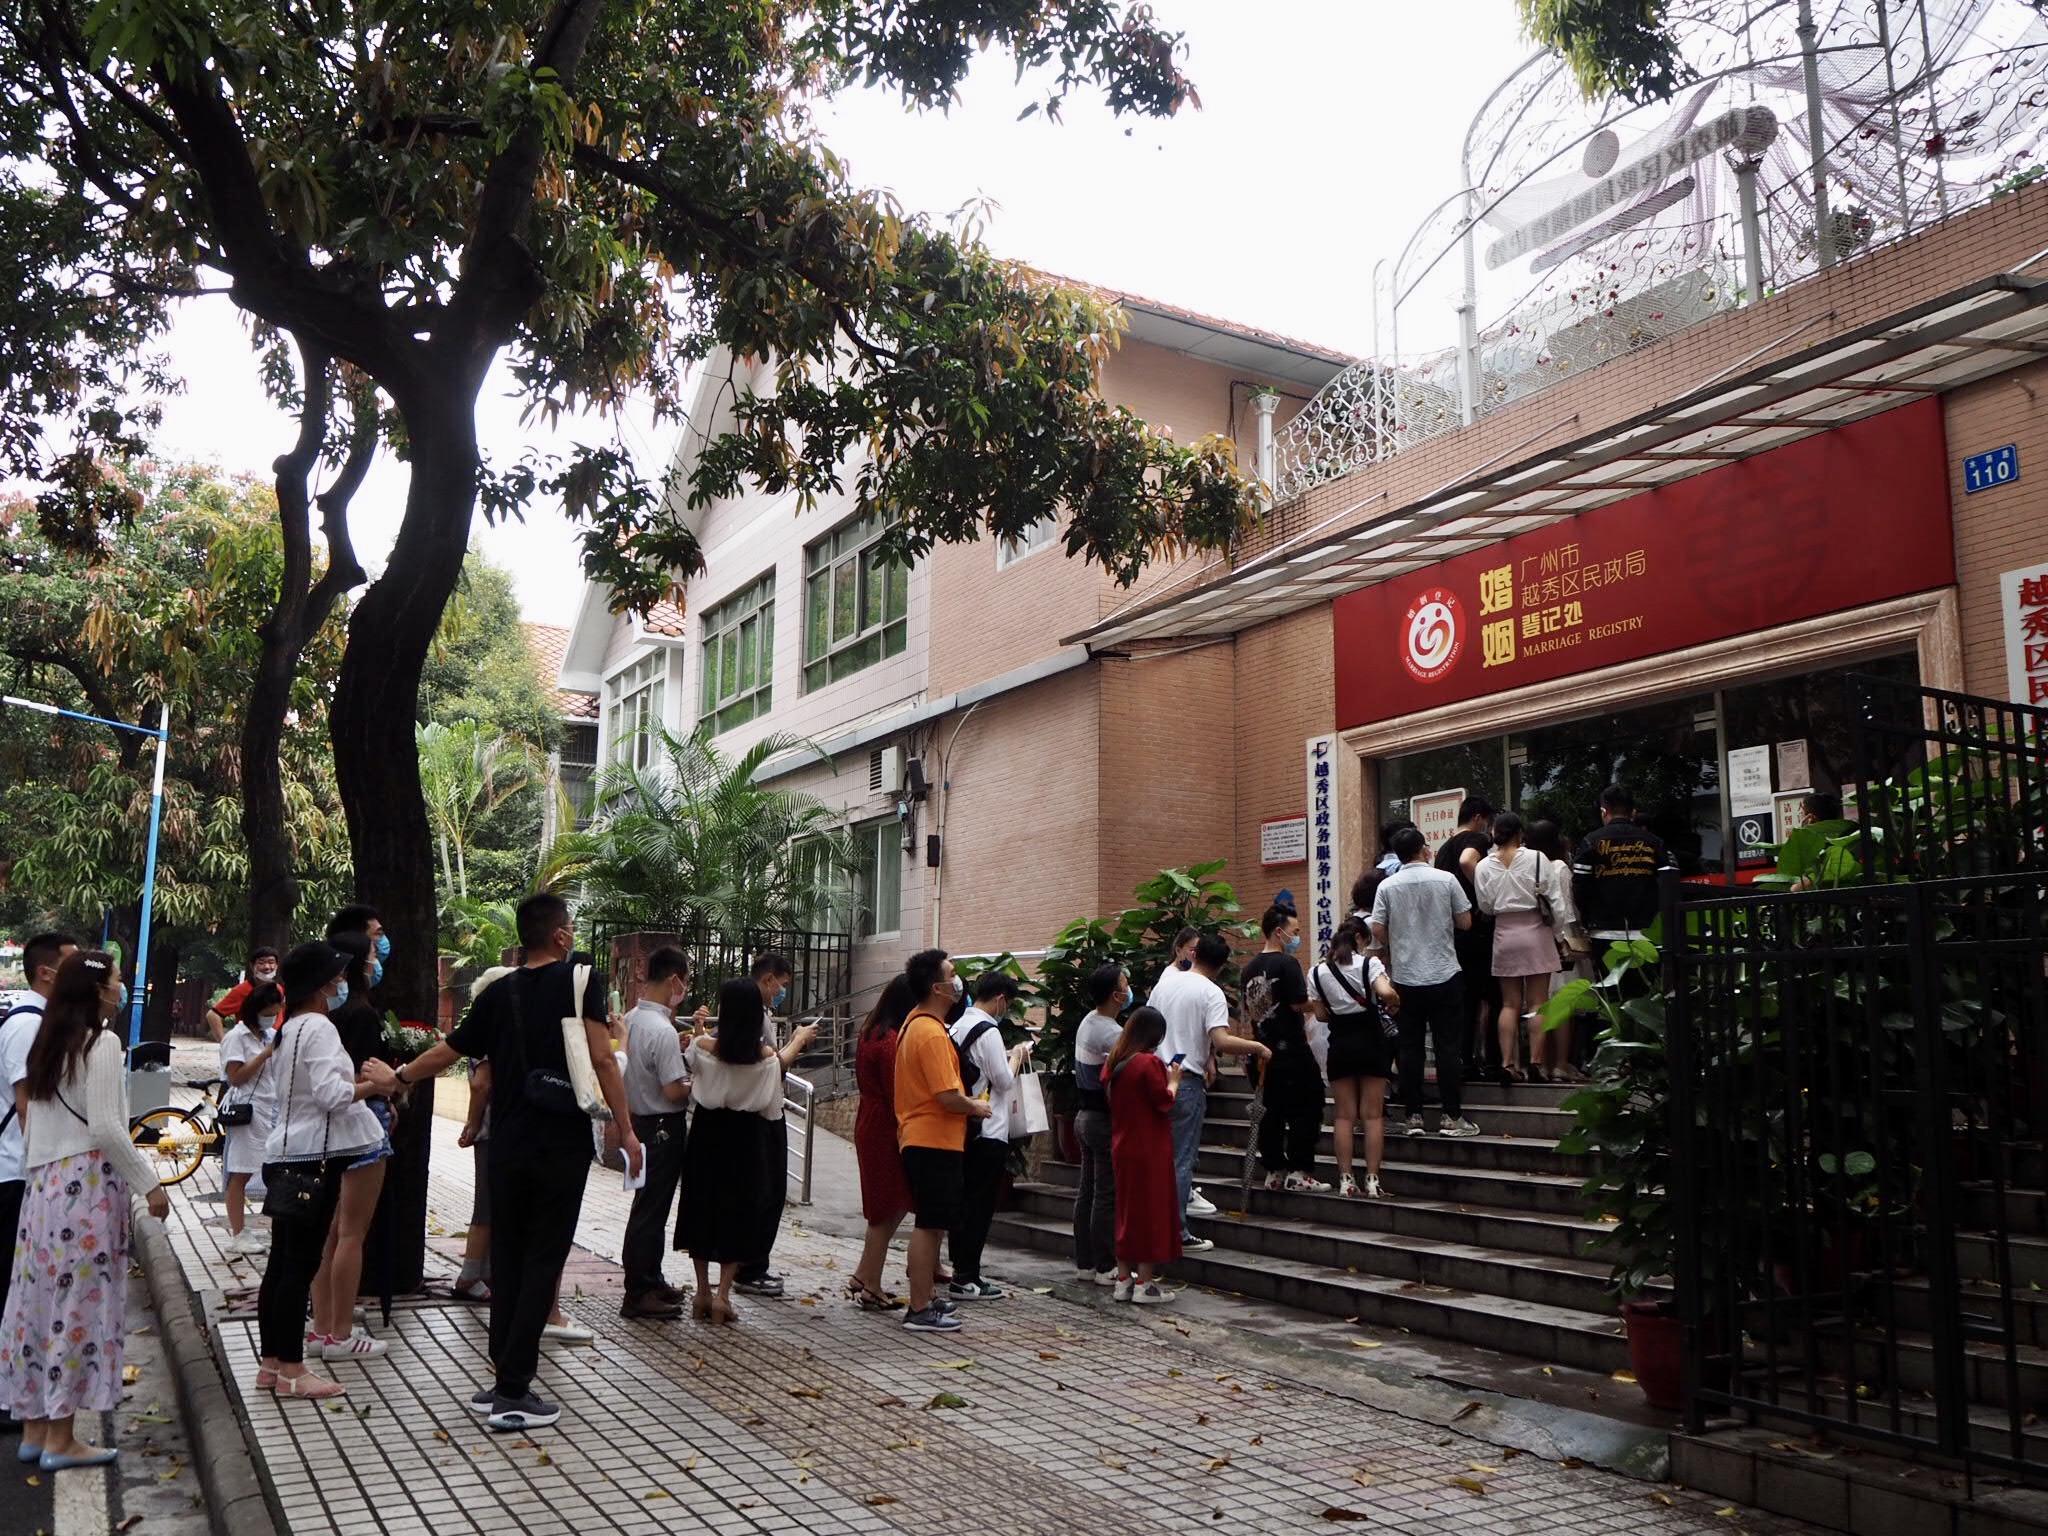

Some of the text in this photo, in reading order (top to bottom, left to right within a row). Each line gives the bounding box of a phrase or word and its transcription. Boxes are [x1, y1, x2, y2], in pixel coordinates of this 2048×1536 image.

[1972, 461, 2009, 486] 110
[1521, 543, 1580, 583] 广州市
[1521, 549, 1647, 608] 越秀区民政局
[1479, 563, 1516, 668] 婚姻
[1521, 600, 1584, 639] 登记处
[1523, 615, 1644, 657] MARRIAGE REGISTRY
[2018, 576, 2048, 735] 越秀区民
